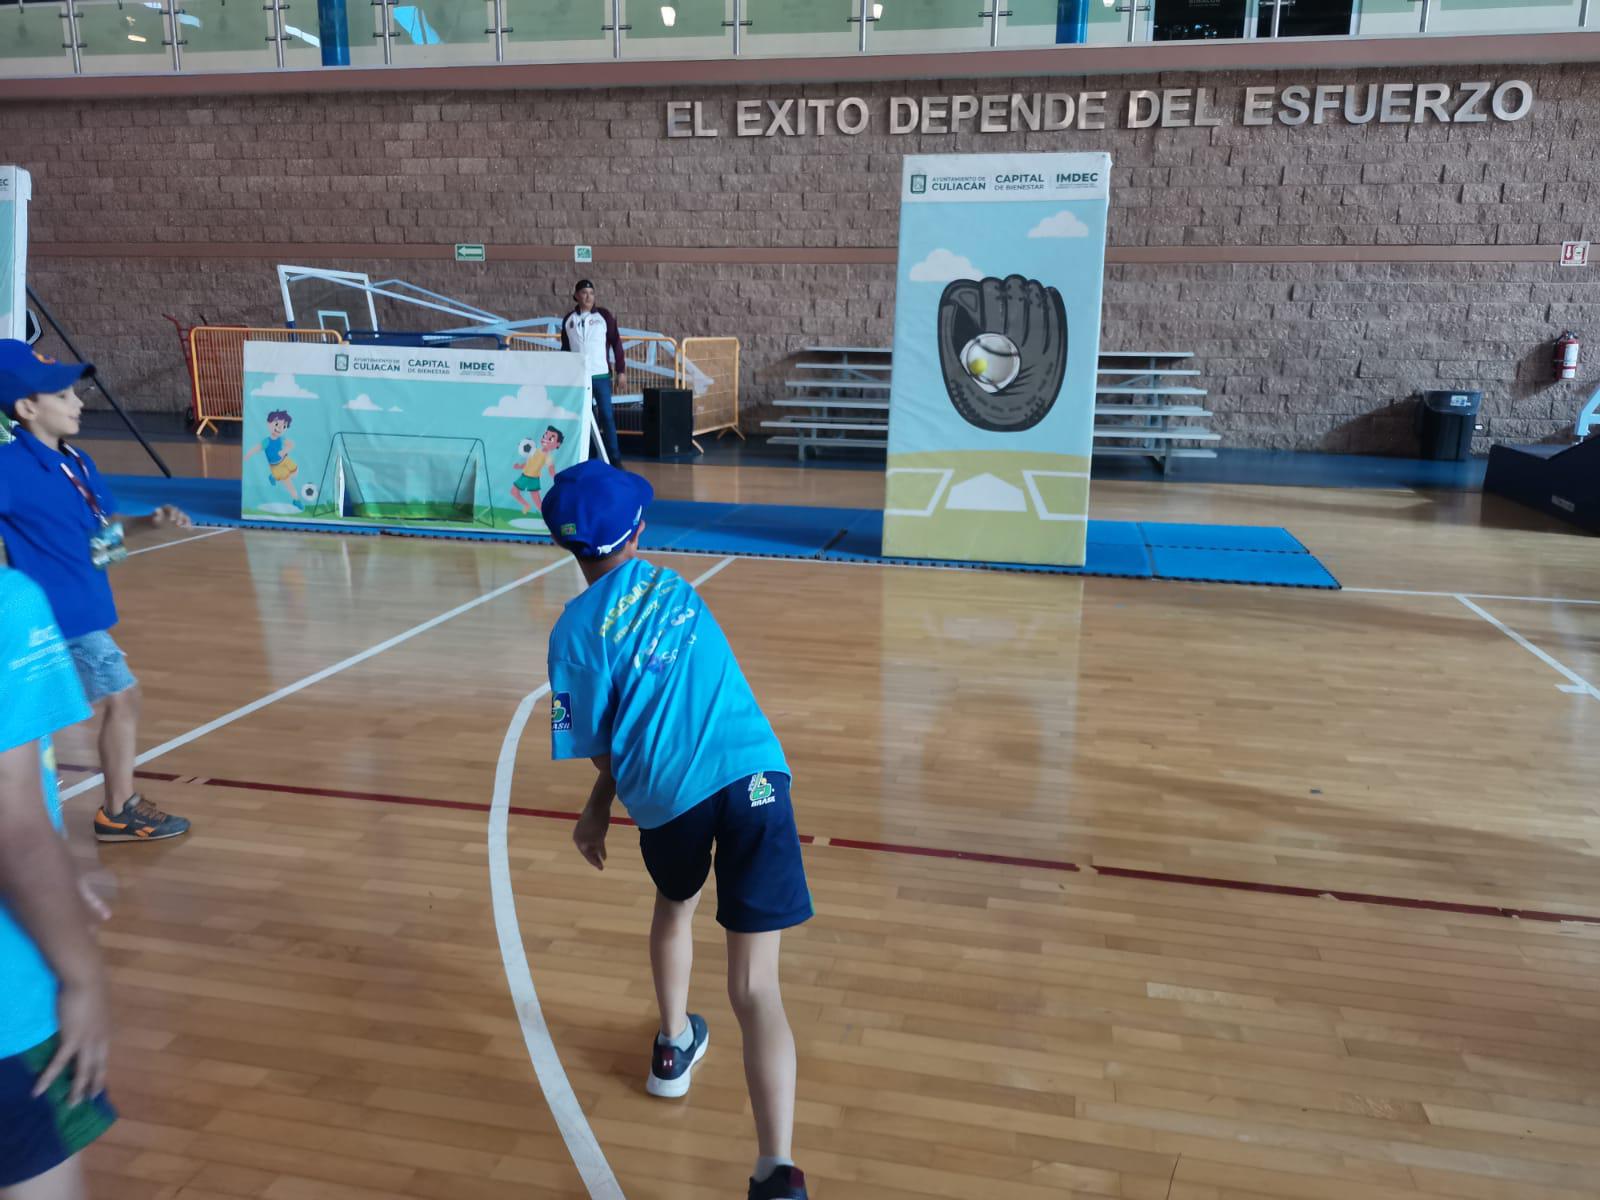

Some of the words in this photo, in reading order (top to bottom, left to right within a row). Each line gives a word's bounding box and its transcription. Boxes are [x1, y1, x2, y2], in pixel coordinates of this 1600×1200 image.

[667, 101, 718, 138] EL
[737, 97, 869, 137] EXITO
[889, 91, 1107, 135] DEPENDE
[1127, 88, 1221, 129] DEL
[1243, 80, 1533, 125] ESFUERZO
[995, 174, 1045, 183] CAPITAL
[1056, 173, 1099, 183] IMDEC
[408, 359, 450, 369] CAPITAL
[459, 361, 495, 371] IMDEC
